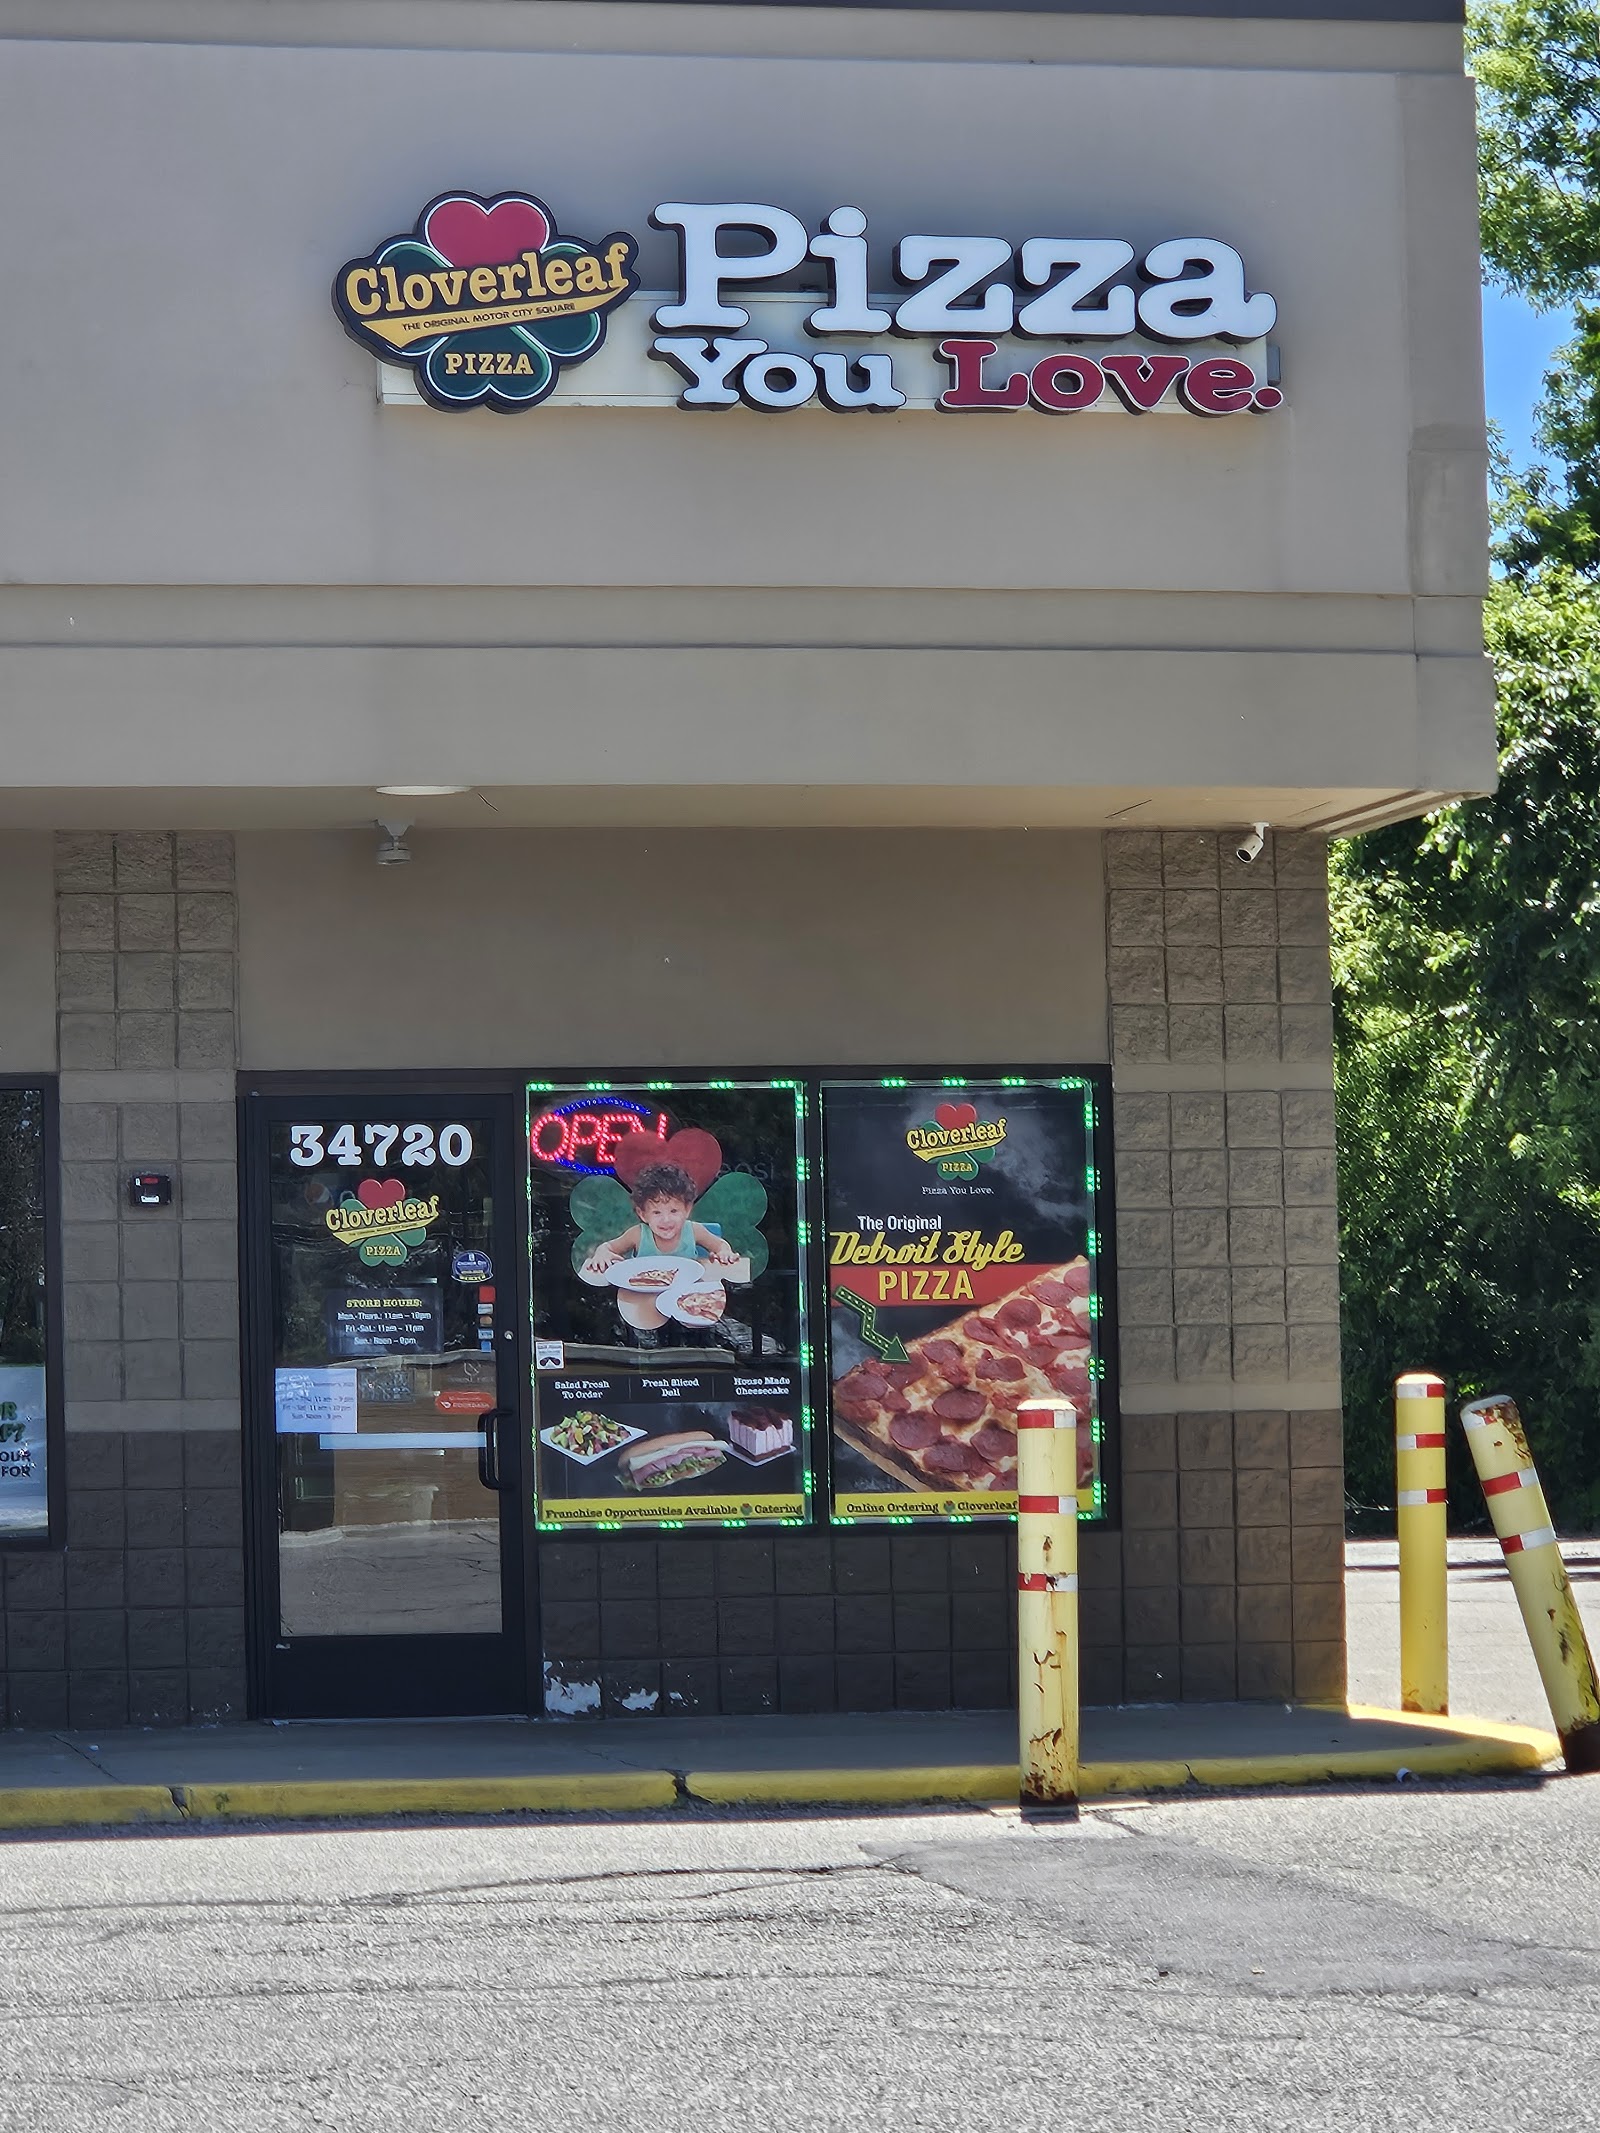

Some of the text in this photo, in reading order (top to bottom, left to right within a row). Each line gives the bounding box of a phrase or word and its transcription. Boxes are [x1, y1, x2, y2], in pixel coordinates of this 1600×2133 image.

[651, 202, 1278, 340] Pizza
[346, 242, 629, 316] Cloverleaf
[402, 303, 576, 332] THE ORIGINAL MOTOR CITY SQUARE
[445, 353, 534, 375] PIZZA
[652, 337, 1284, 414] You Love.
[907, 1118, 1007, 1149] Cloverleaf
[290, 1124, 473, 1167] 34720
[942, 1162, 973, 1172] PIZZA
[921, 1186, 995, 1195] Pizza You Love.
[326, 1195, 440, 1231] Cloverleaf
[857, 1214, 942, 1233] The Original
[366, 1246, 402, 1257] PIZZA
[829, 1230, 1026, 1271] Detroit Style
[879, 1270, 974, 1300] PIZZA
[346, 1299, 423, 1308] STORE HOURS:
[554, 1380, 610, 1389] Salad Fresh
[642, 1377, 700, 1387] Fresh Sliced
[734, 1376, 790, 1386] House Made
[562, 1390, 604, 1399] To Order
[661, 1388, 681, 1397] Deli
[735, 1386, 790, 1396] Cheesecake
[545, 1503, 803, 1518] Franchise Opportunities Available Catering
[846, 1503, 885, 1513] Online
[887, 1502, 939, 1514] Ordering
